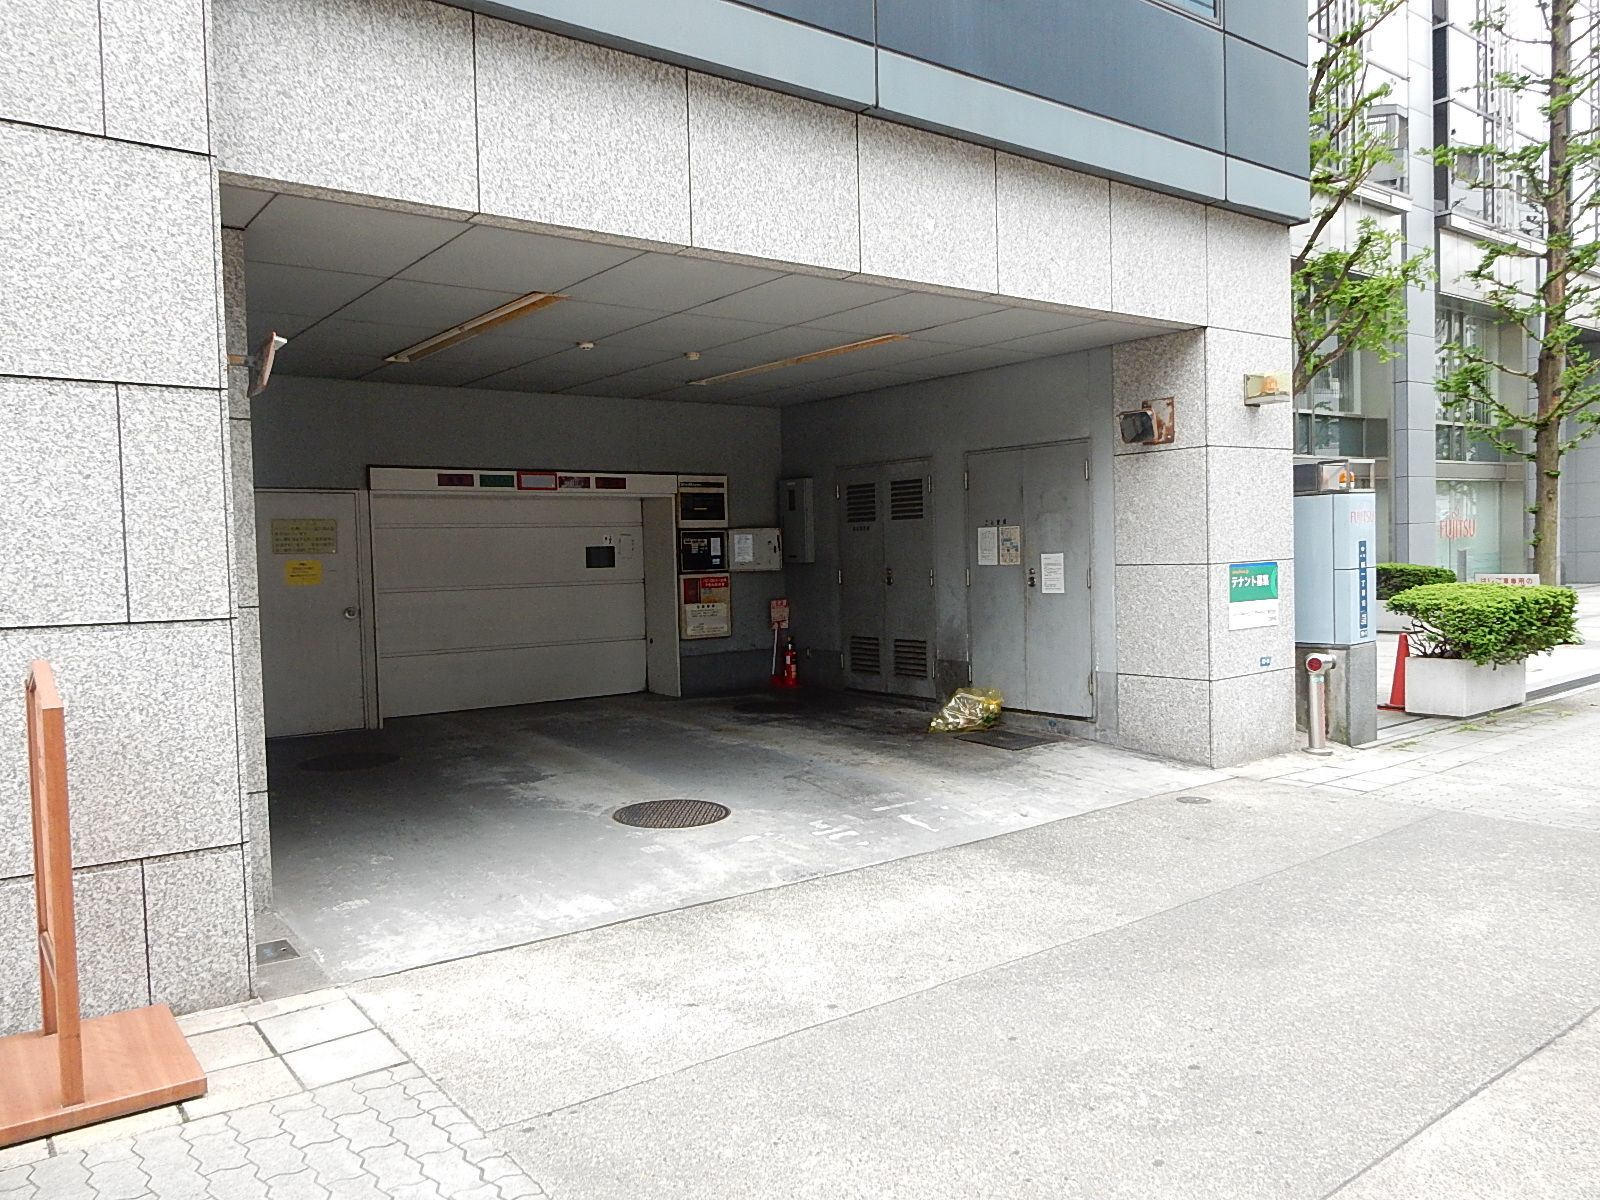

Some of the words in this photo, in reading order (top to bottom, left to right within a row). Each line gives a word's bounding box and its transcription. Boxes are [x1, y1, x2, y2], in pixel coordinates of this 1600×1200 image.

[1440, 519, 1475, 540] FUJITSU
[1231, 574, 1270, 588] テナント募集
